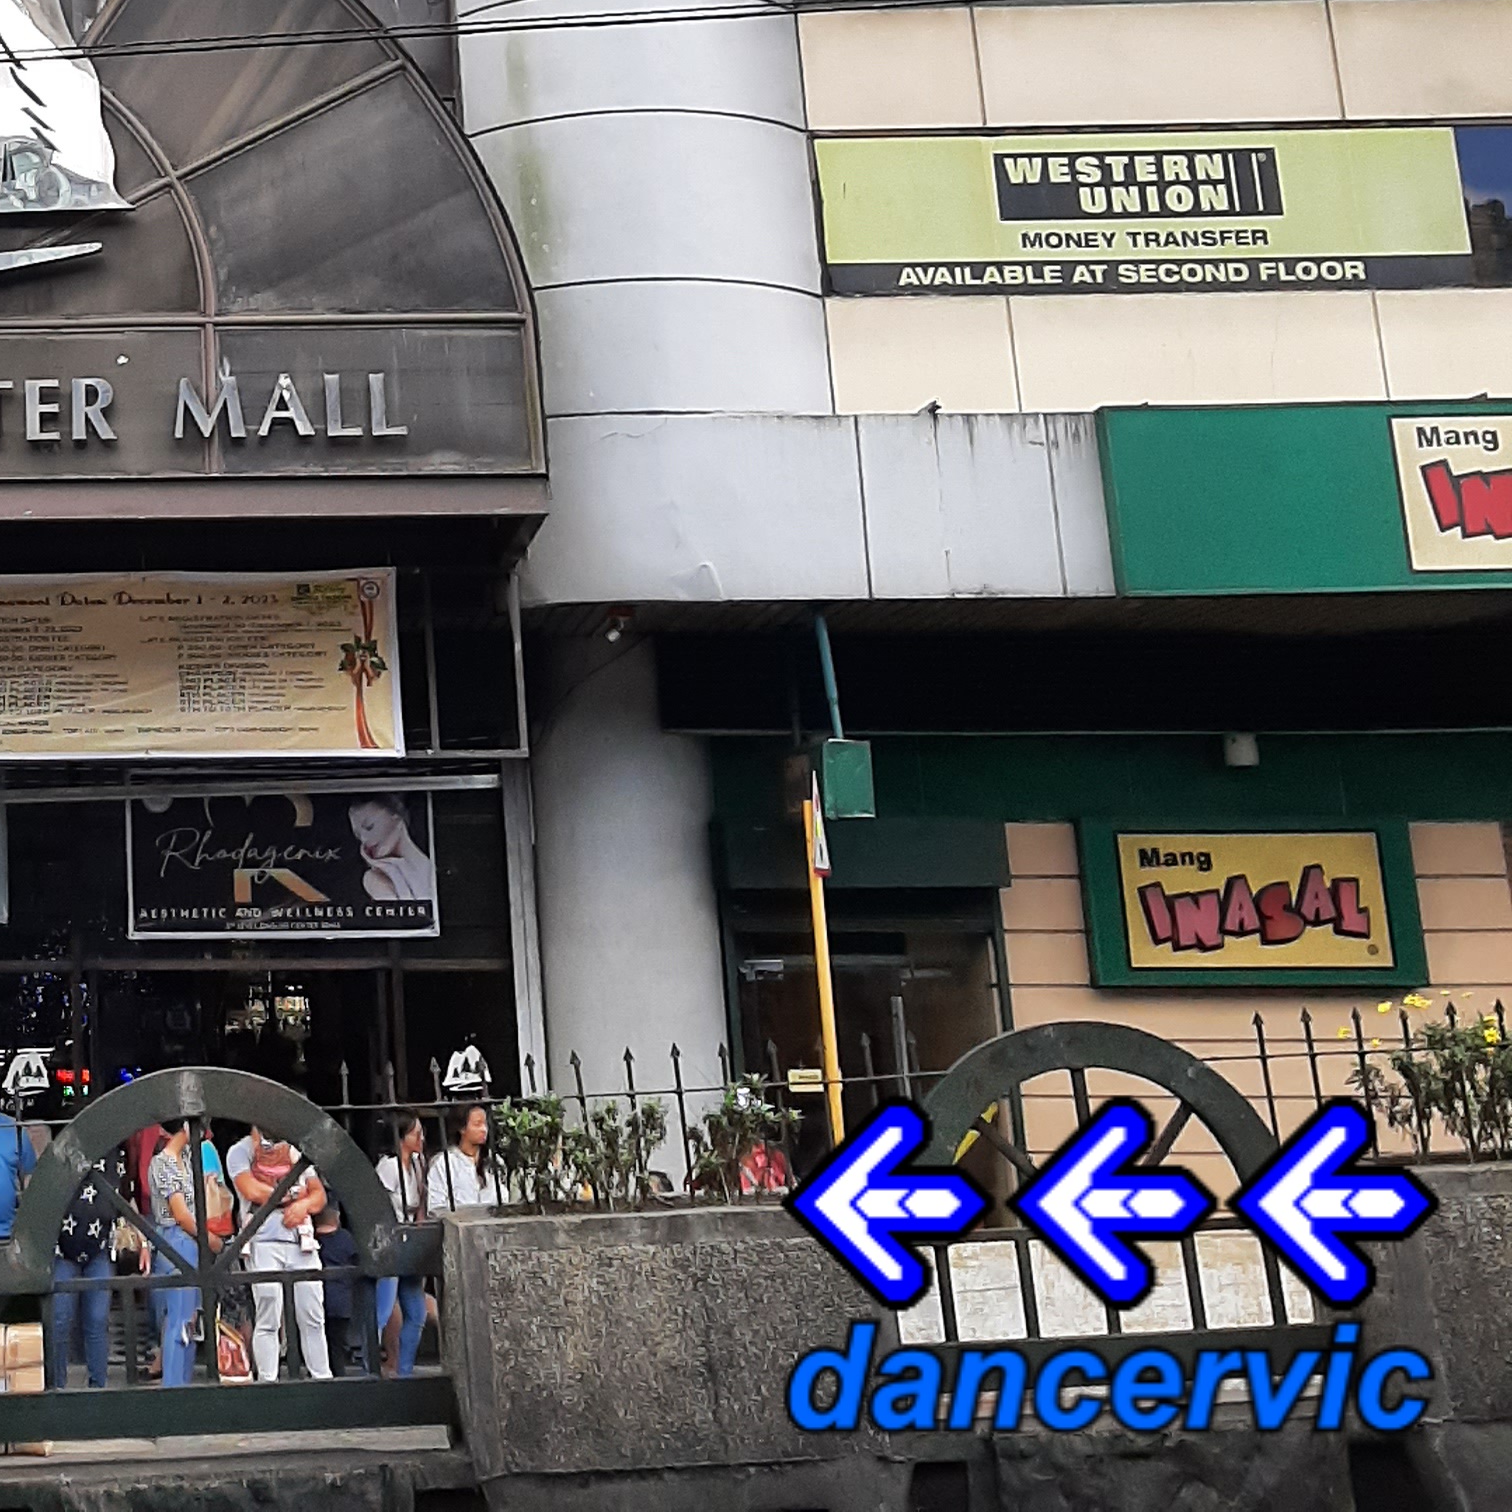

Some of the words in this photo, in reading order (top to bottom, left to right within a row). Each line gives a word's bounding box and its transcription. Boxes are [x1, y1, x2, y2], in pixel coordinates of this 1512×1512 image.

[1002, 153, 1226, 184] WESTERN
[1078, 183, 1230, 214] UNION
[1021, 232, 1117, 249] MONEY
[1125, 229, 1270, 248] TRANSFER
[898, 263, 1065, 288] AVAILABLE
[1071, 263, 1109, 283] AT
[1117, 261, 1250, 284] SECOND
[1259, 259, 1367, 283] FLOOR
[173, 372, 409, 440] MALL
[1415, 425, 1500, 452] Mang
[1137, 846, 1214, 872] Mang
[138, 907, 227, 921] AESTHETIC
[235, 906, 262, 919] AND
[270, 905, 355, 919] WELLNESS
[364, 905, 427, 917] CENTER
[1136, 863, 1371, 953] INASAL
